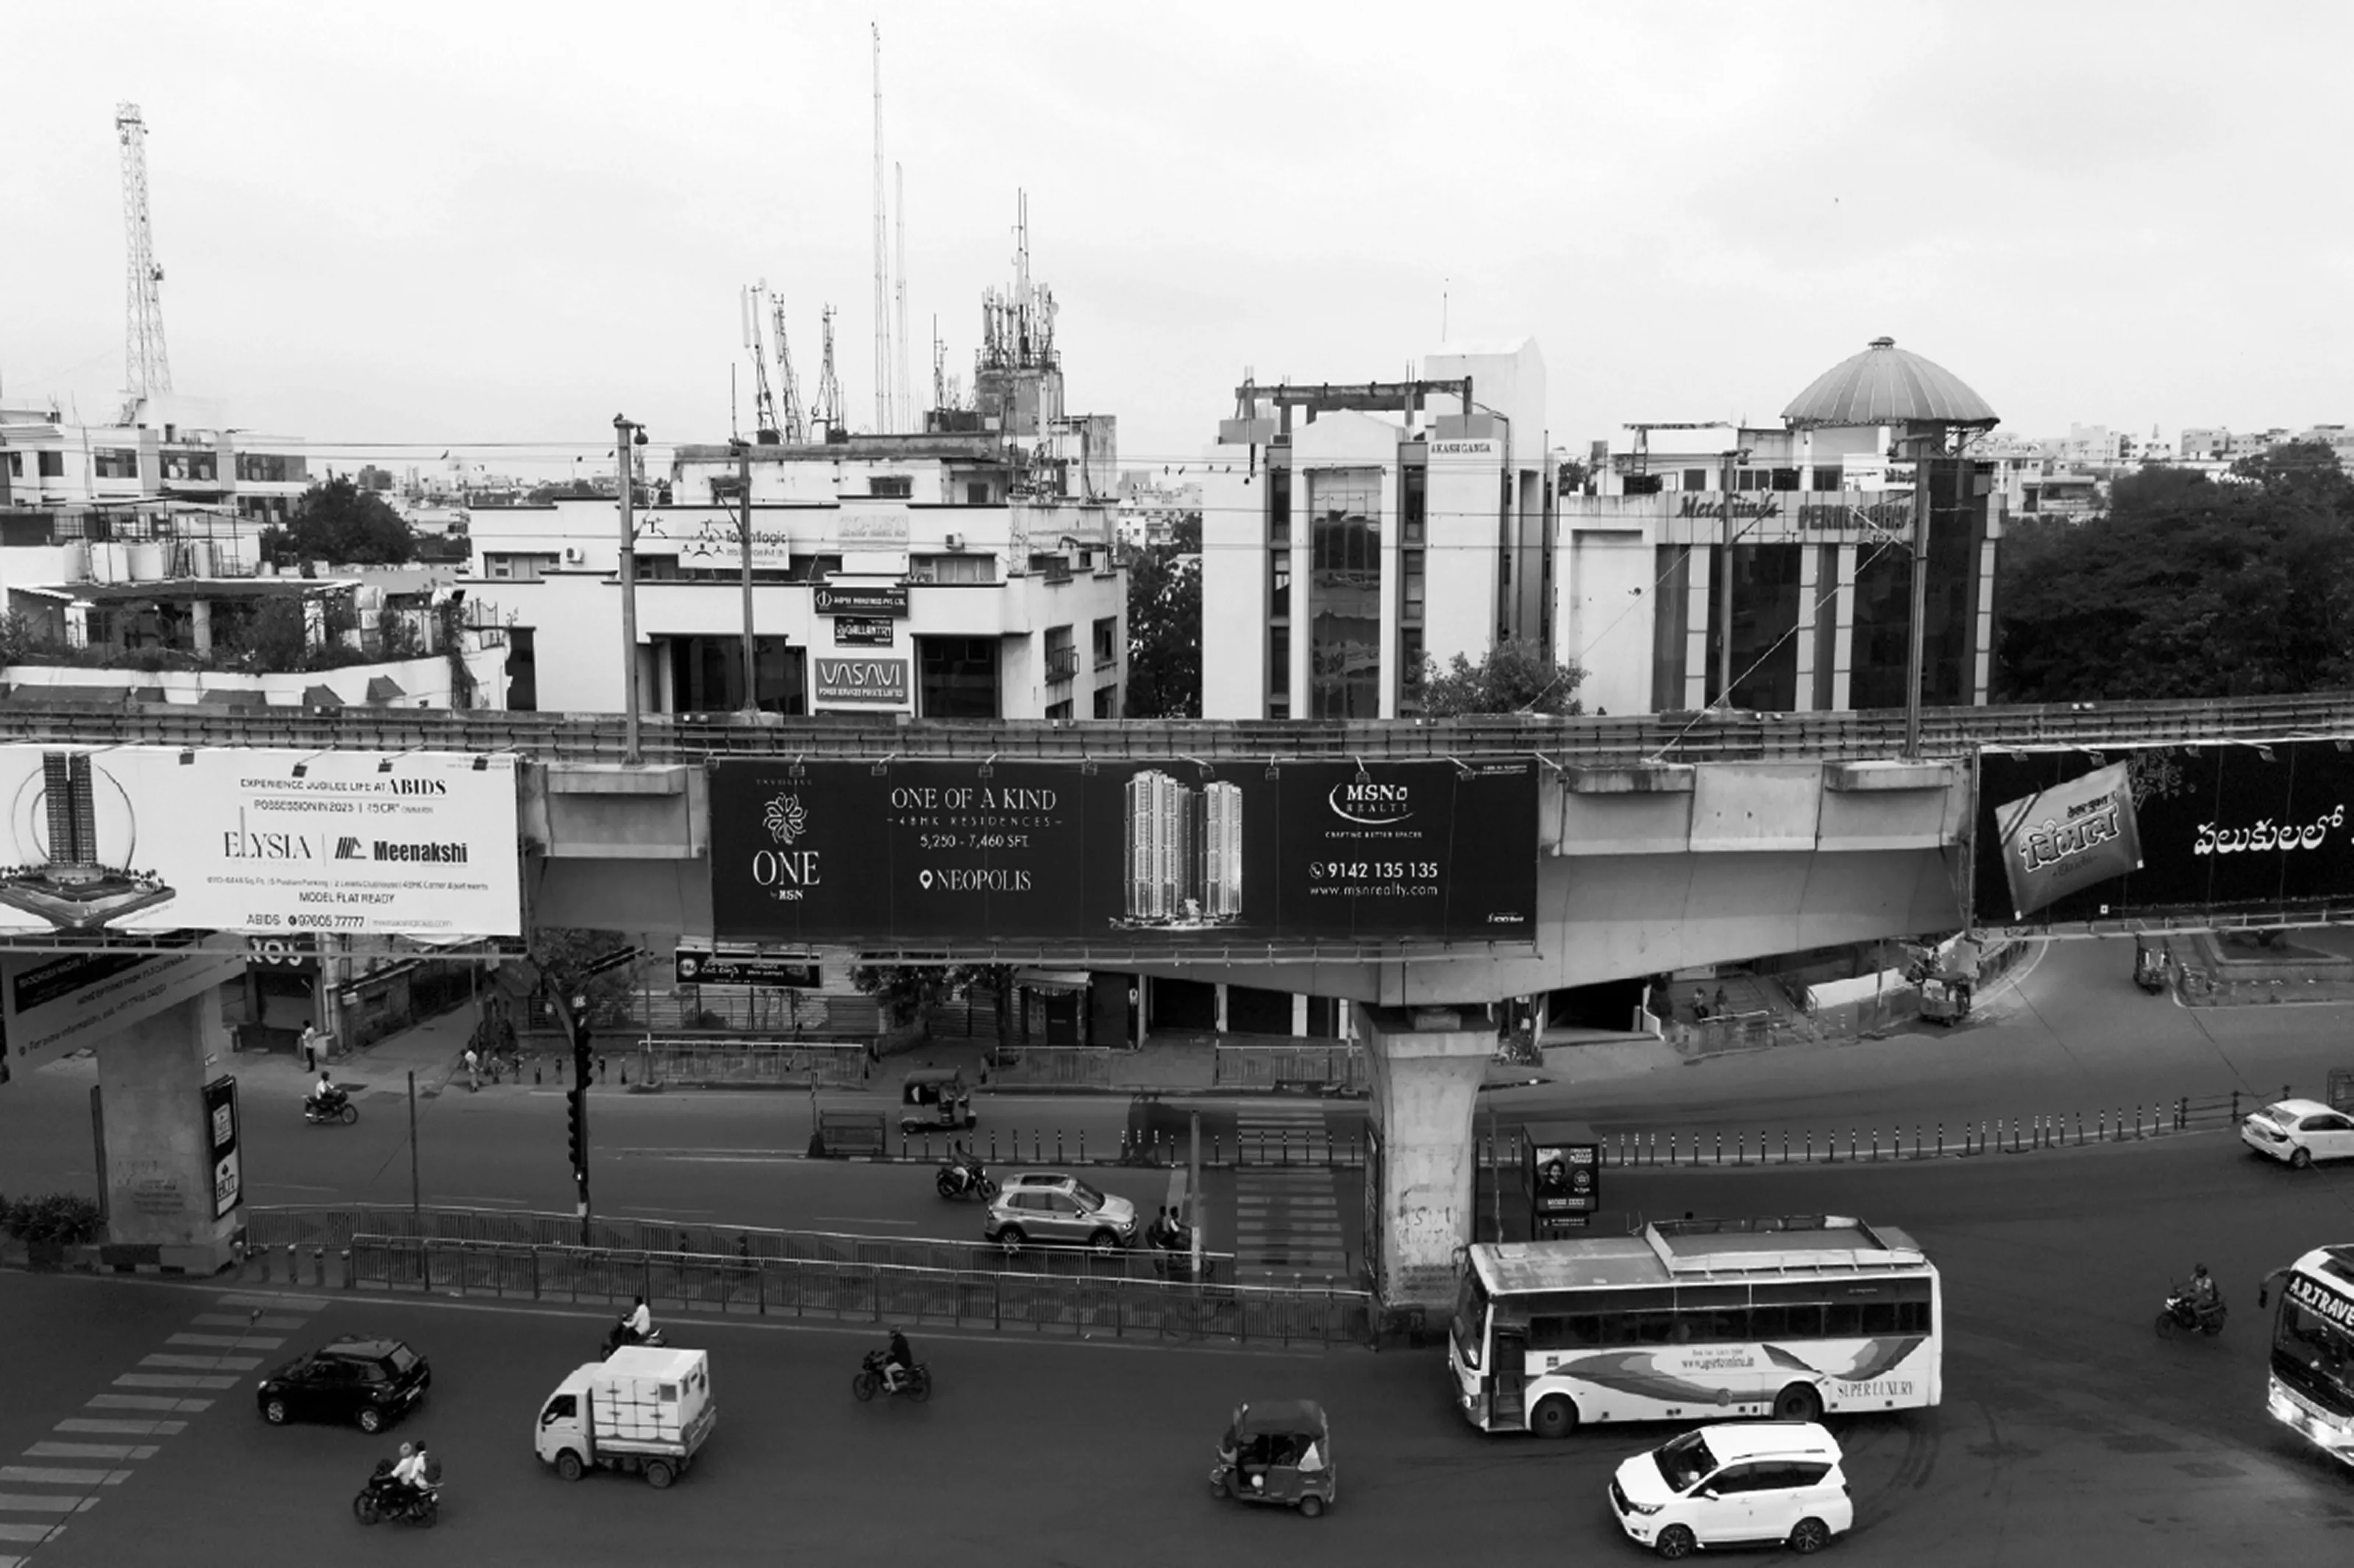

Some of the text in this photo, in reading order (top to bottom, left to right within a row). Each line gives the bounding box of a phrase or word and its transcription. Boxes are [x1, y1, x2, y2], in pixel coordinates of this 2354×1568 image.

[820, 663, 900, 685] VASAVI
[241, 778, 304, 791] EXPERIENCE
[387, 778, 447, 795] ABIDS
[255, 799, 317, 813] POSSESSION
[892, 787, 1057, 810] ONE OF A KIND
[950, 816, 1050, 827] RESIDENCES
[224, 805, 312, 859] ELYSIA
[920, 834, 956, 849] 5,250
[374, 841, 469, 863] Meenakshi
[753, 850, 822, 885] ONE
[1327, 862, 1438, 878] 9142 135 135
[936, 869, 1031, 891] NEOPOLIS
[1310, 882, 1438, 897] www.msnrealty.com
[299, 891, 395, 905] MODEL FLAT READY
[246, 913, 281, 926] ABIDS
[1838, 1382, 1871, 1398] SUPER
